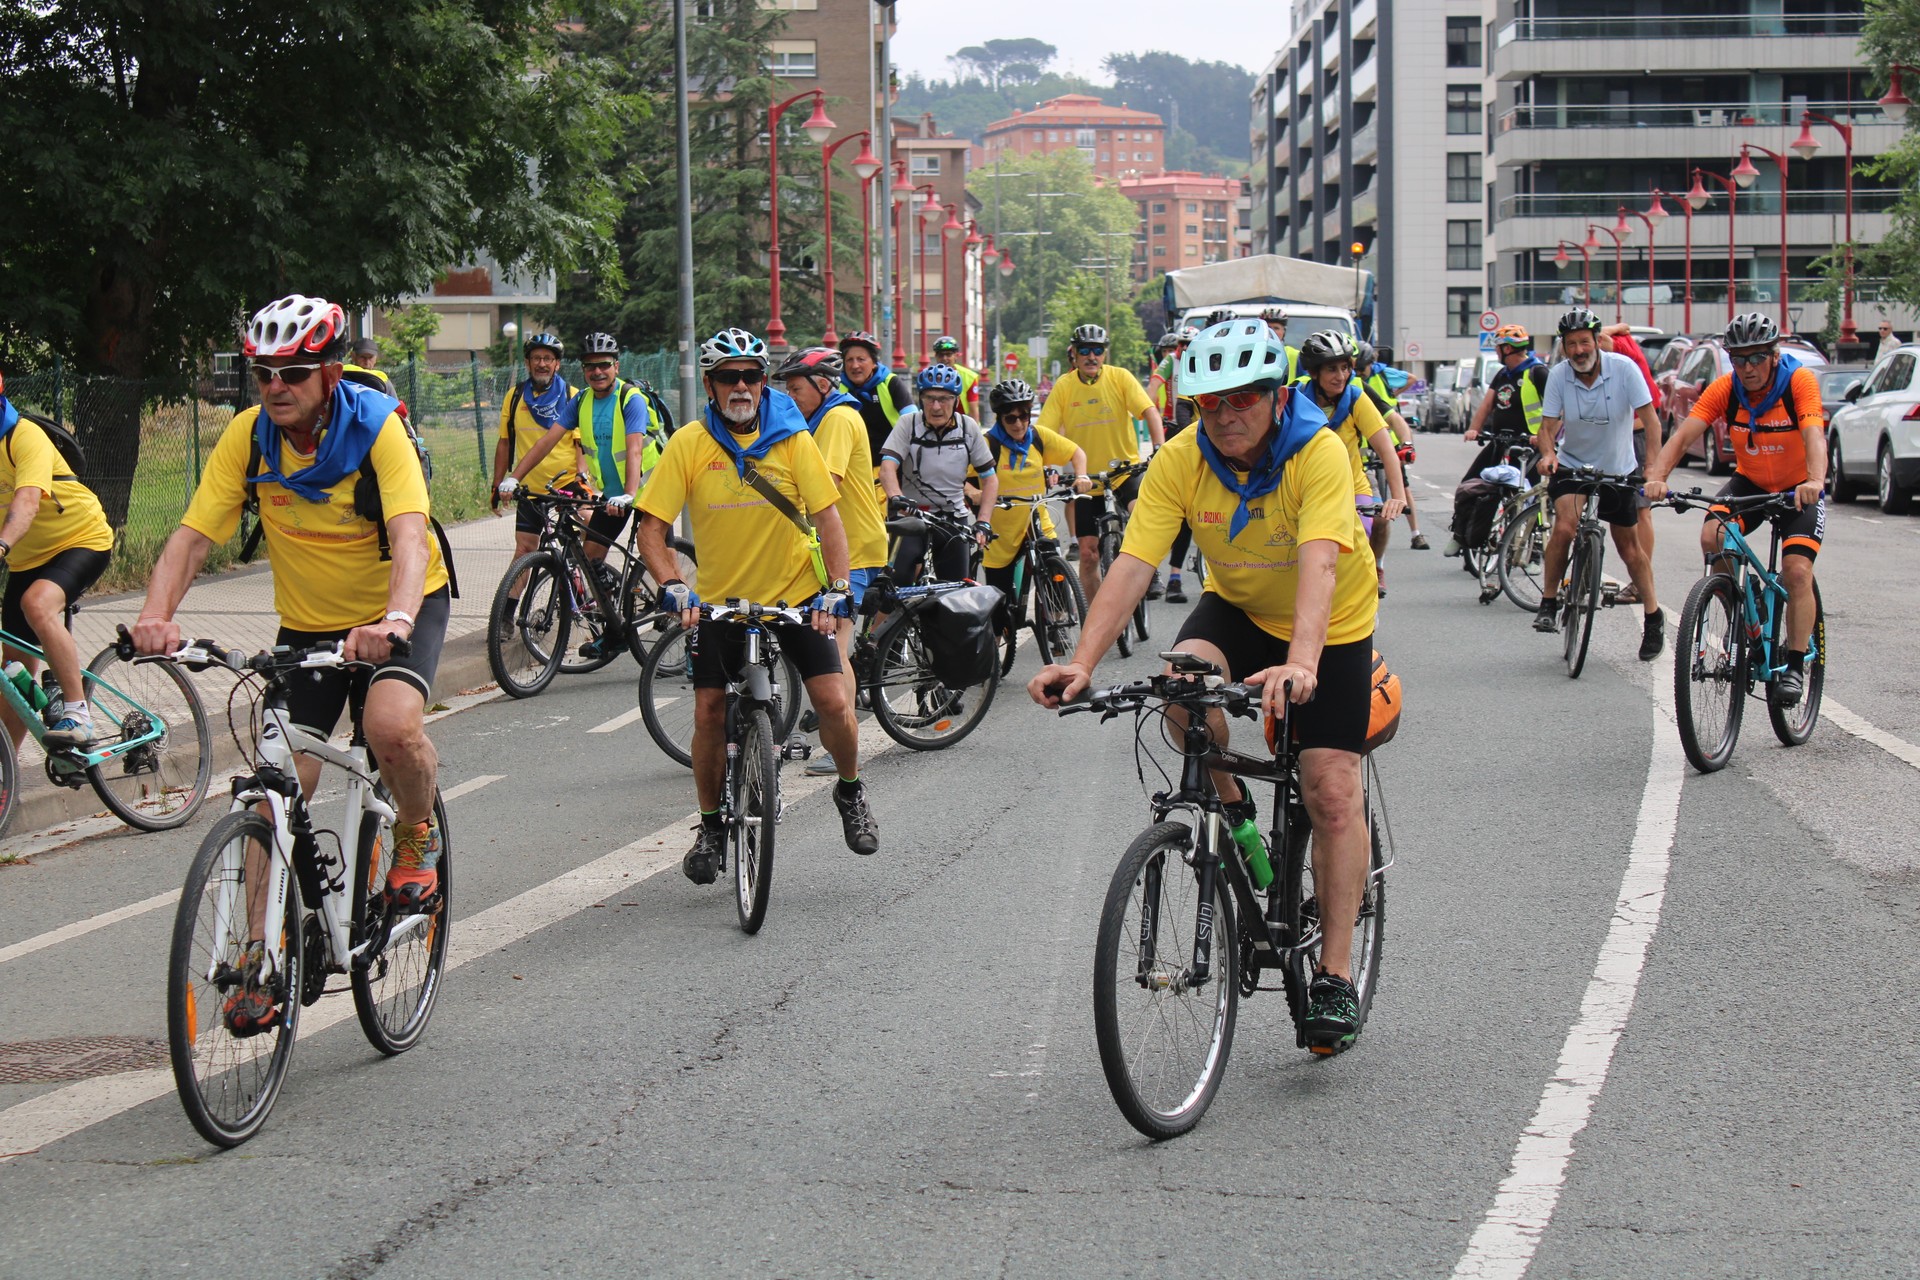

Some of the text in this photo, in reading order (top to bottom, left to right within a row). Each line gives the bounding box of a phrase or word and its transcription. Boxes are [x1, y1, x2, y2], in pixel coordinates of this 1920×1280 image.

[1484, 317, 1495, 325] 30
[1761, 444, 1785, 452] DBA
[1818, 622, 1826, 666] MAXXIS
[1197, 902, 1214, 943] SID
[289, 956, 297, 1007] GIANT
